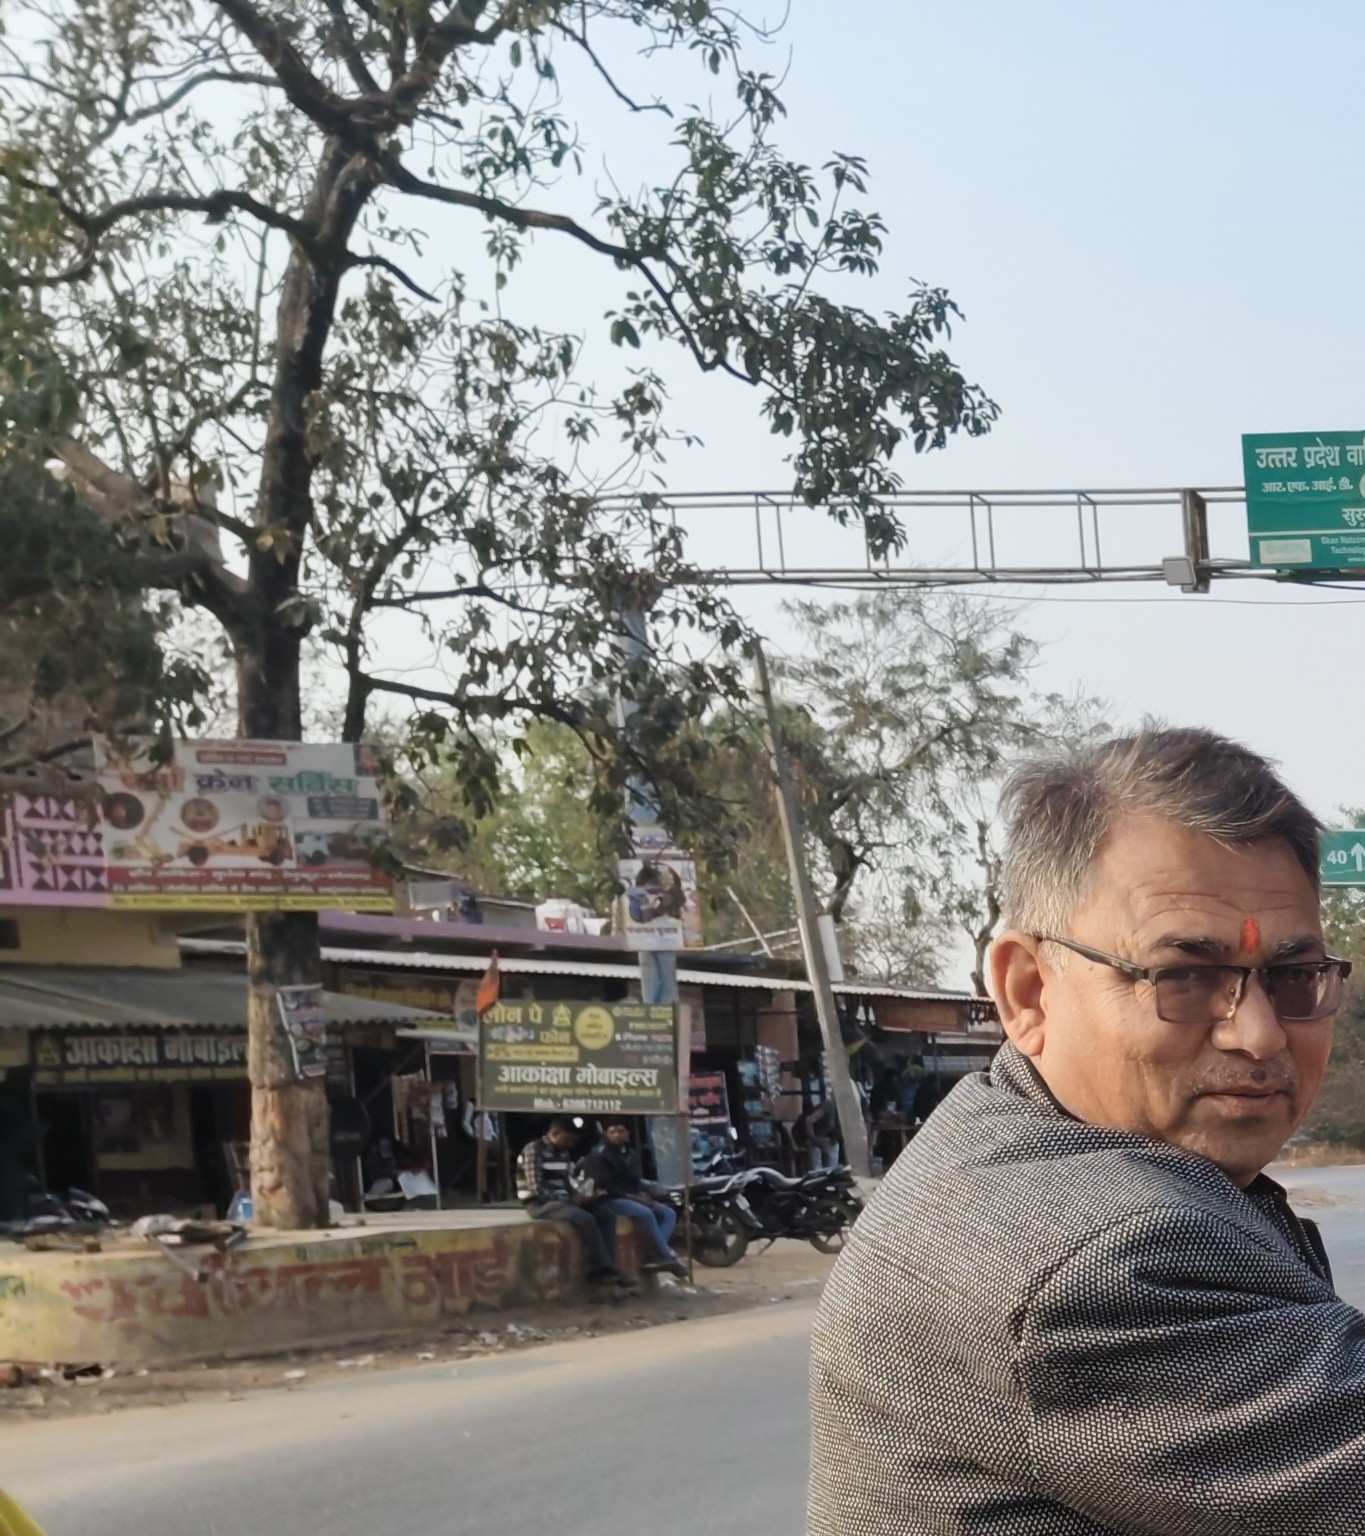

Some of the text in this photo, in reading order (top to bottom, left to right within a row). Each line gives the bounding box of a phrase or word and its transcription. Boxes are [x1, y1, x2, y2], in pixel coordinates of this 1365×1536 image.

[1256, 447, 1298, 469] उत्तर
[1303, 437, 1341, 469] प्रदेश
[1327, 850, 1347, 865] 40
[499, 1061, 571, 1085] आकांक्षा
